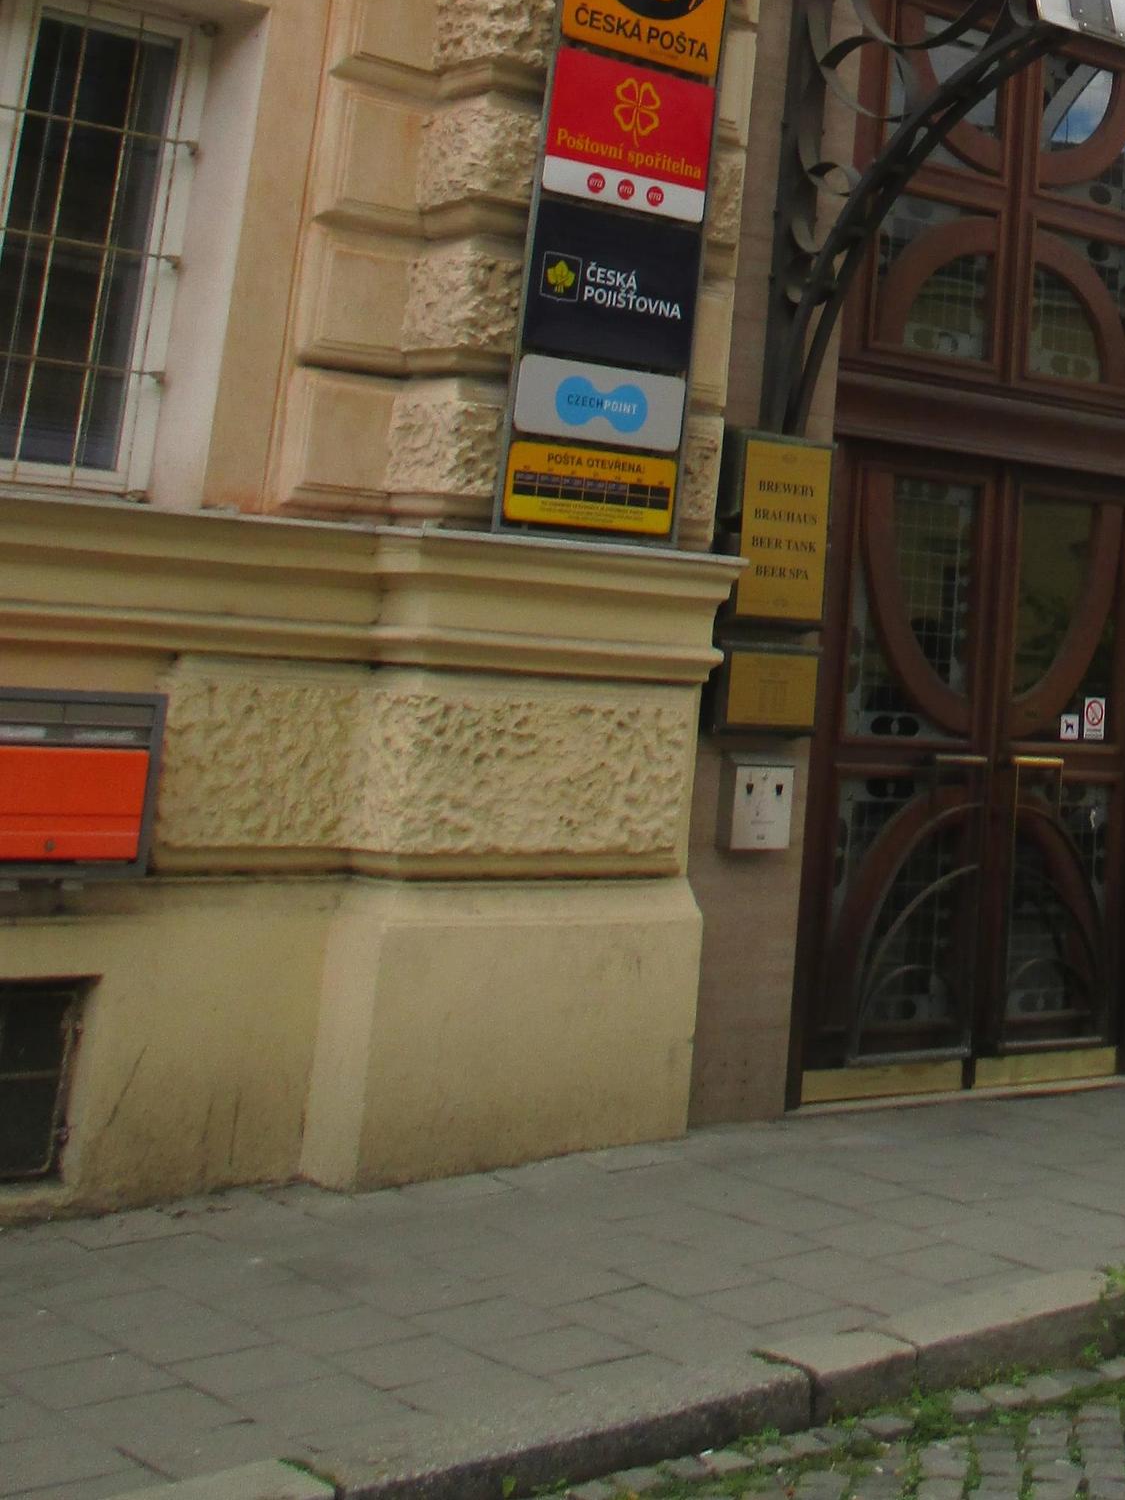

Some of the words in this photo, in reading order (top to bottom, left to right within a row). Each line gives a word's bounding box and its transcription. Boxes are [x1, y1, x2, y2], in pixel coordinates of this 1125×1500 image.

[574, 3, 643, 42] ČESKÁ
[646, 26, 709, 61] POŠTA
[556, 128, 625, 162] Poštovní
[627, 148, 702, 180] spořitelna
[588, 177, 604, 189] era
[619, 185, 635, 196] era
[648, 191, 663, 202] era
[585, 262, 638, 291] ČESKÁ
[583, 285, 682, 320] POJIŠŤOVNA
[547, 451, 583, 467] POŠTA
[758, 479, 816, 498] BREWERY
[754, 507, 818, 526] BRAUHAUS
[752, 535, 786, 549] BEER
[786, 538, 817, 553] TANK
[755, 564, 787, 579] BEER
[788, 567, 809, 581] SPA
